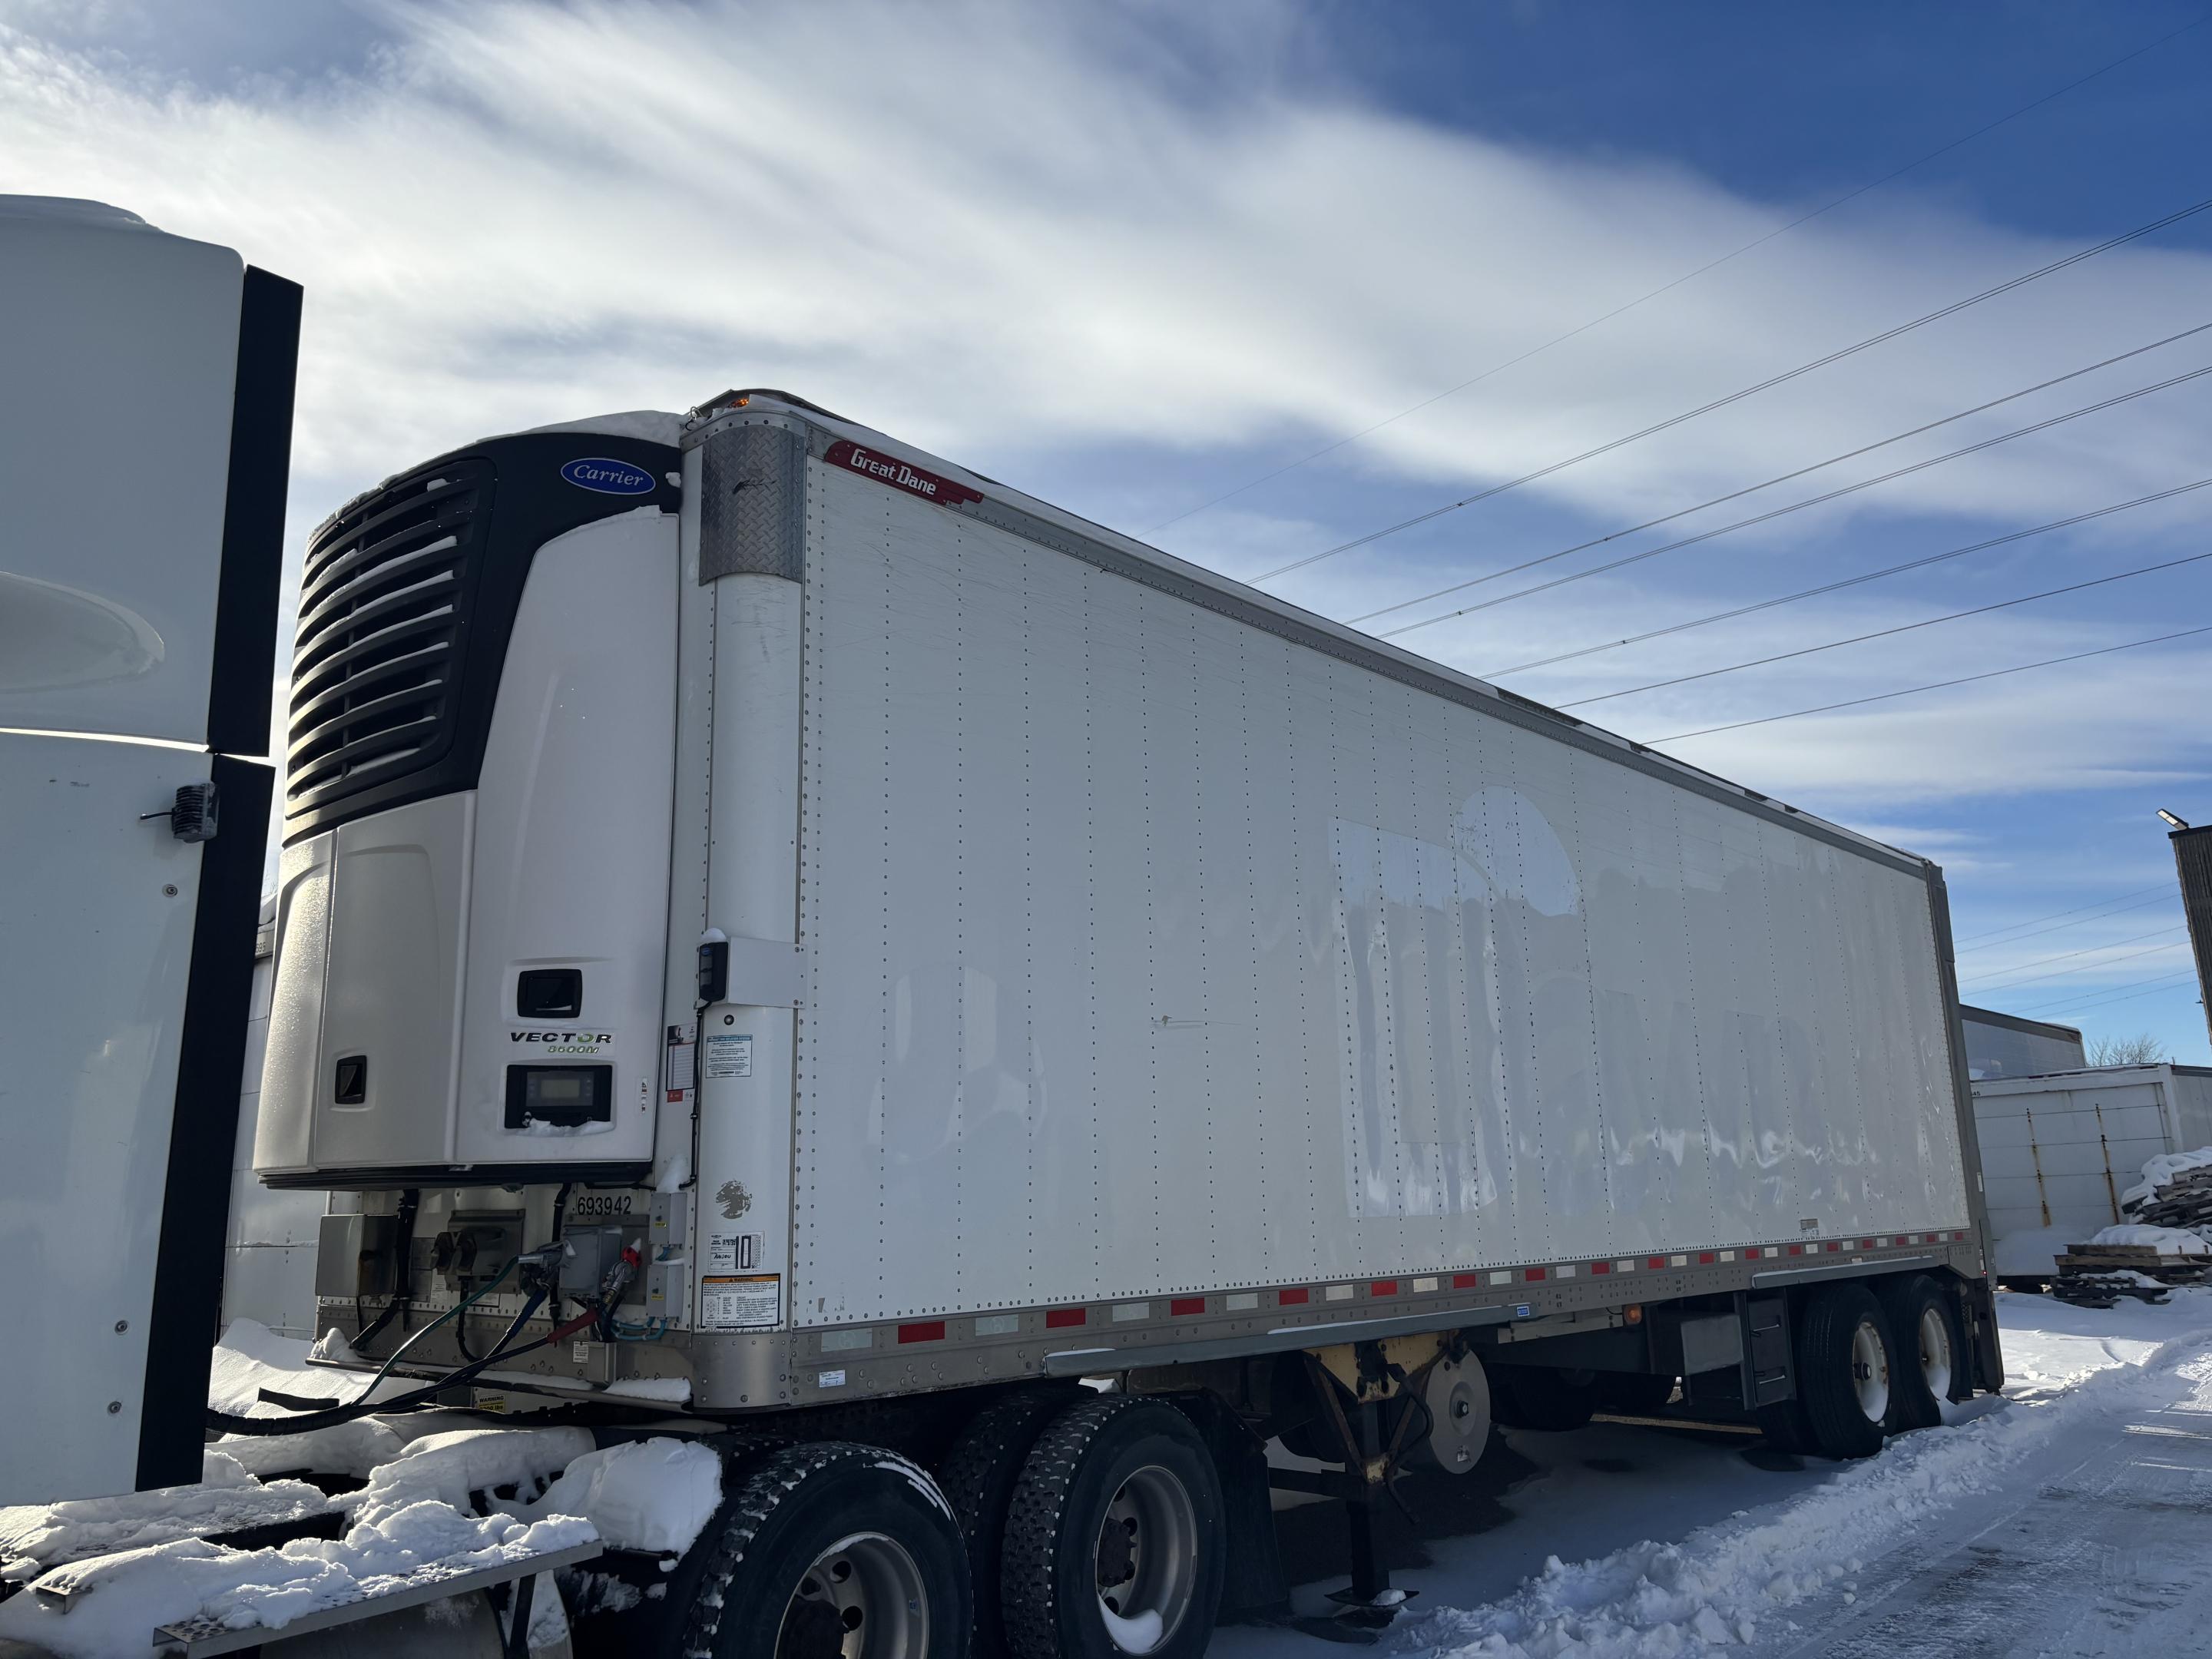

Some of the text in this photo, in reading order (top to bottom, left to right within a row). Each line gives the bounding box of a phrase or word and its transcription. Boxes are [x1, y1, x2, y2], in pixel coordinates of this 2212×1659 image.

[574, 465, 644, 485] Carrier
[850, 448, 936, 495] Great Dane
[510, 1032, 612, 1043] VECTOR
[578, 1196, 631, 1215] 693942
